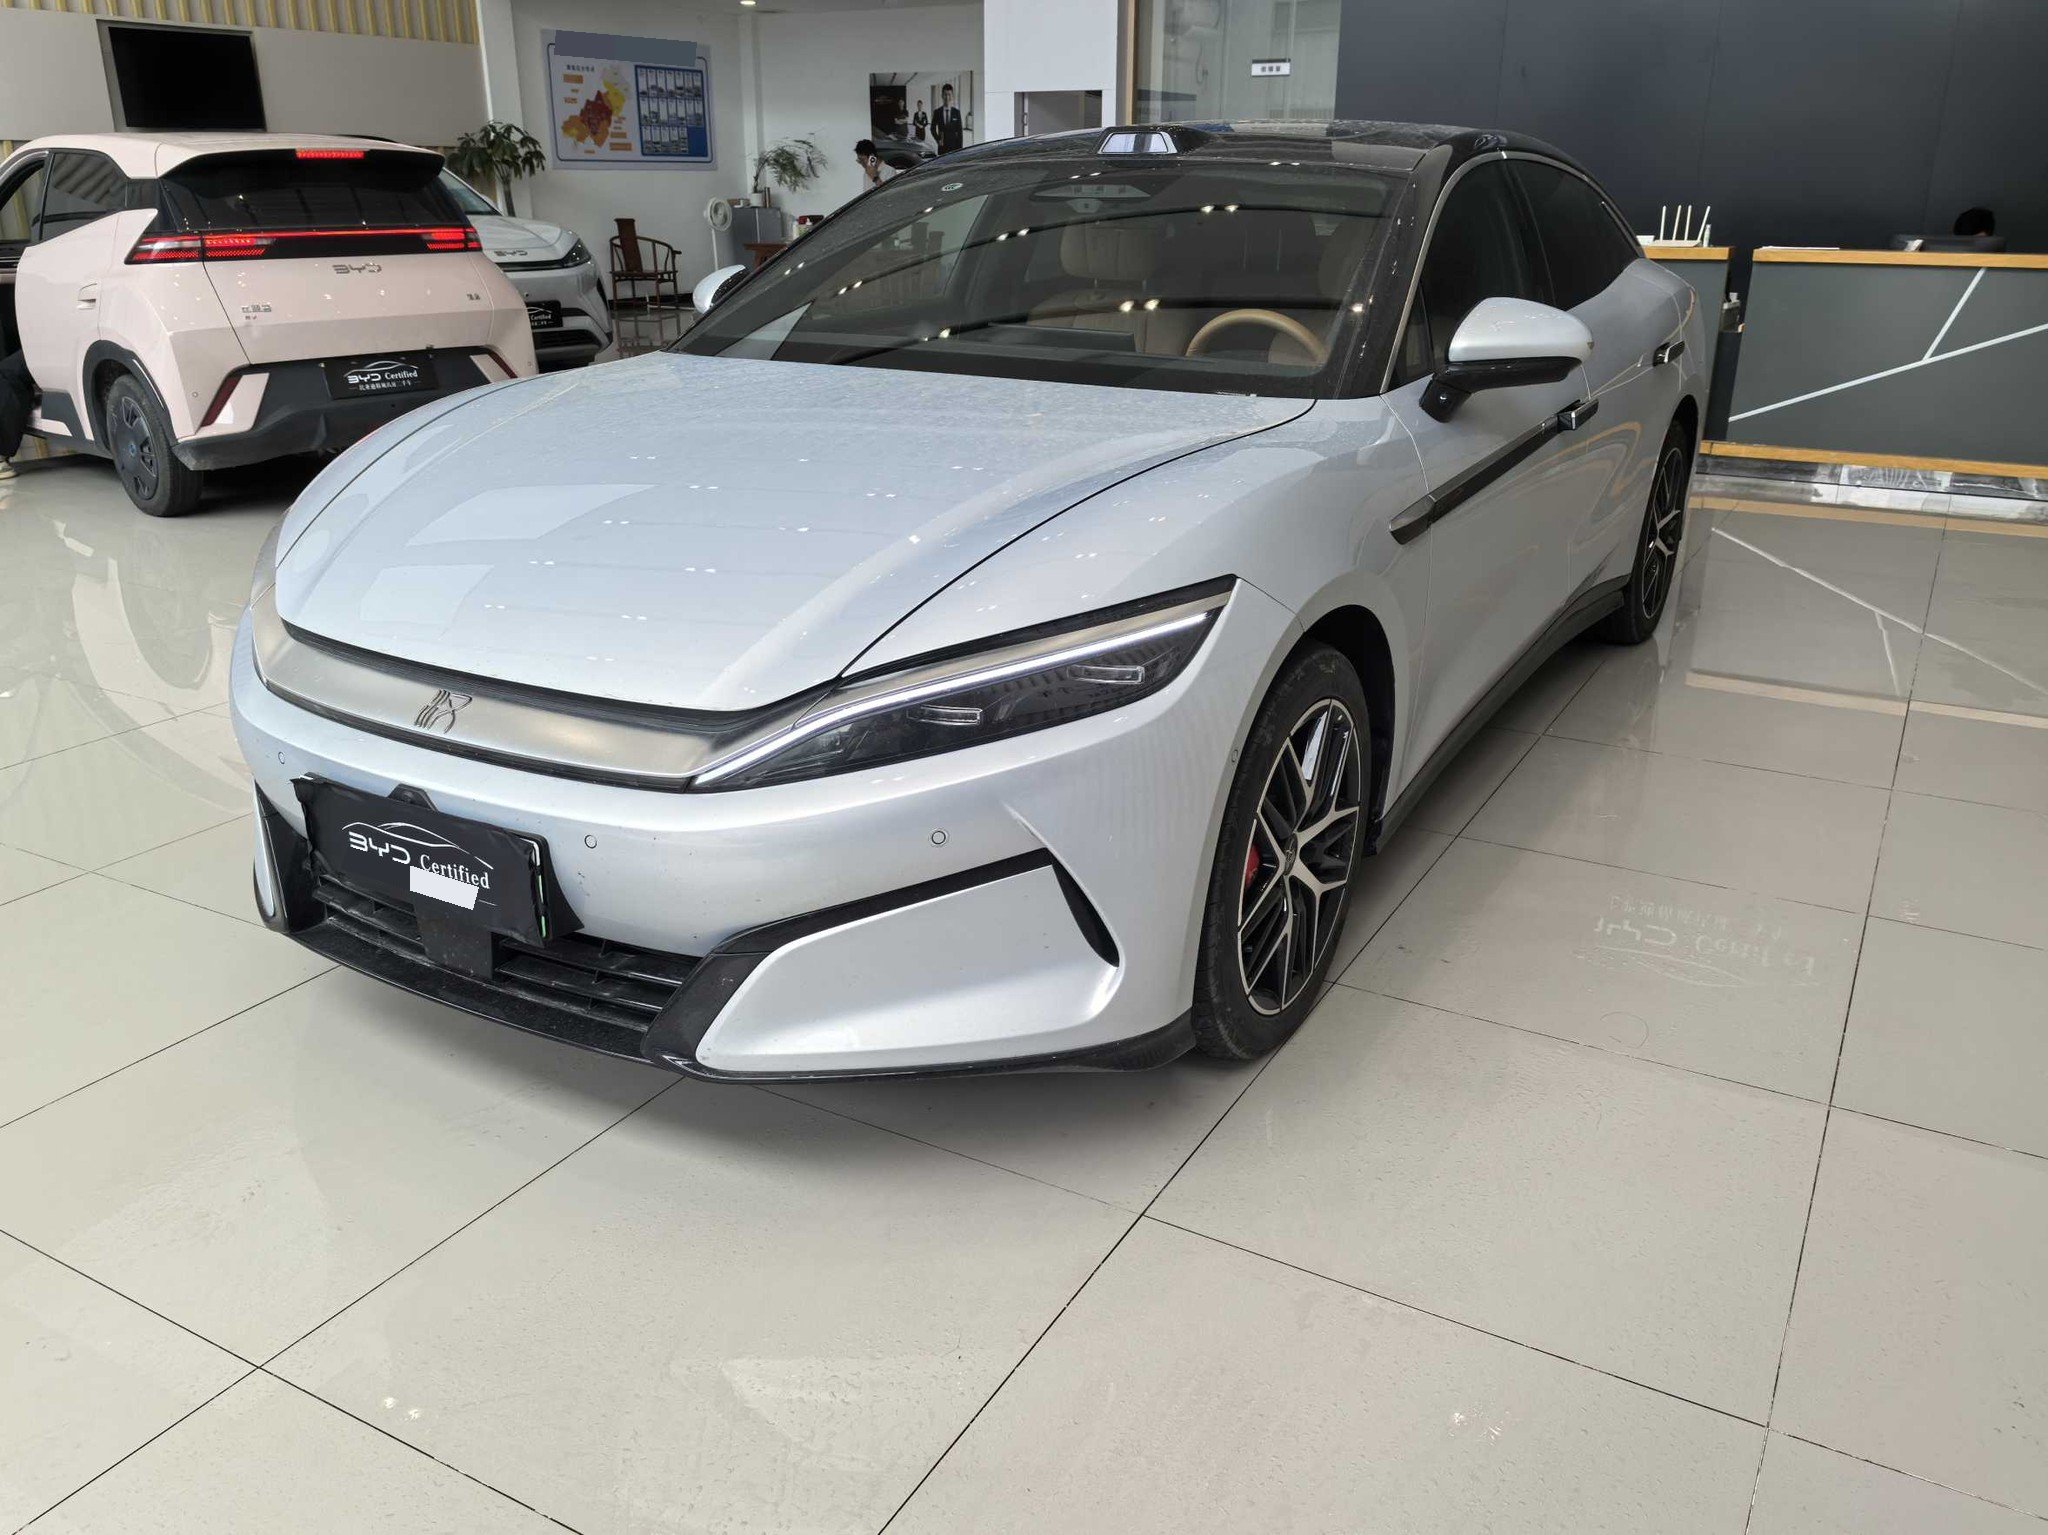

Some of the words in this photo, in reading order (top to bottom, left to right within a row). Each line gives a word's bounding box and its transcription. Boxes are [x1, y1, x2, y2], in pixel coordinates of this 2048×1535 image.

[332, 263, 382, 274] BYD
[347, 372, 381, 384] BYD
[384, 369, 418, 381] Certified
[349, 831, 411, 865] BYD
[420, 854, 490, 889] Certified
